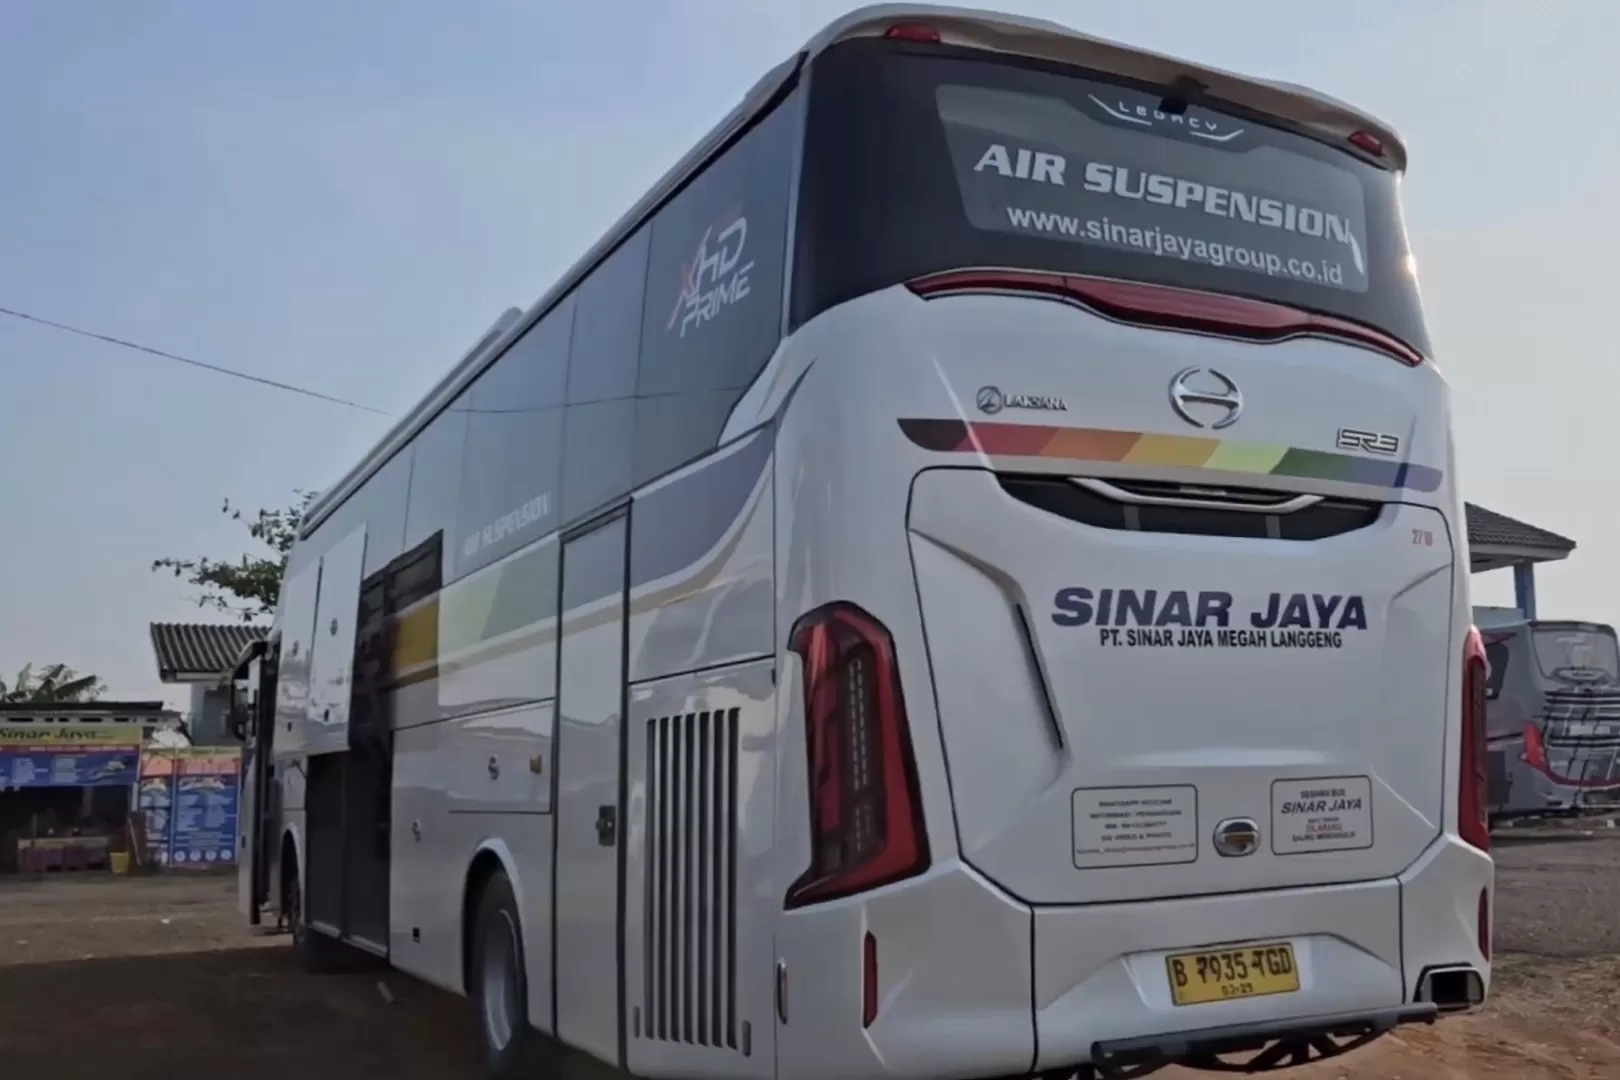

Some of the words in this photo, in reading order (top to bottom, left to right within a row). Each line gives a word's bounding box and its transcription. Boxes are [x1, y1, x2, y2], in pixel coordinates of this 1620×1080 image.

[1119, 101, 1218, 131] LEGACY
[974, 143, 1066, 185] AIR
[1084, 163, 1351, 244] SUSPENSION
[1007, 207, 1343, 285] www.sinarjayagroup.co.id
[1003, 394, 1068, 411] LAKSANA
[1051, 587, 1233, 627] SINAR
[1251, 593, 1367, 629] JAYA
[1100, 628, 1122, 647] PT.
[1127, 628, 1173, 647] SINAR
[1177, 629, 1214, 647] JAYA
[1217, 629, 1267, 648] MEGAH
[1270, 630, 1342, 648] LANGGENG
[1281, 800, 1327, 814] SINAR
[1328, 797, 1362, 812] JAYA
[1172, 959, 1188, 987] B
[1196, 951, 1248, 984] 7935
[1252, 947, 1292, 978] TGD
